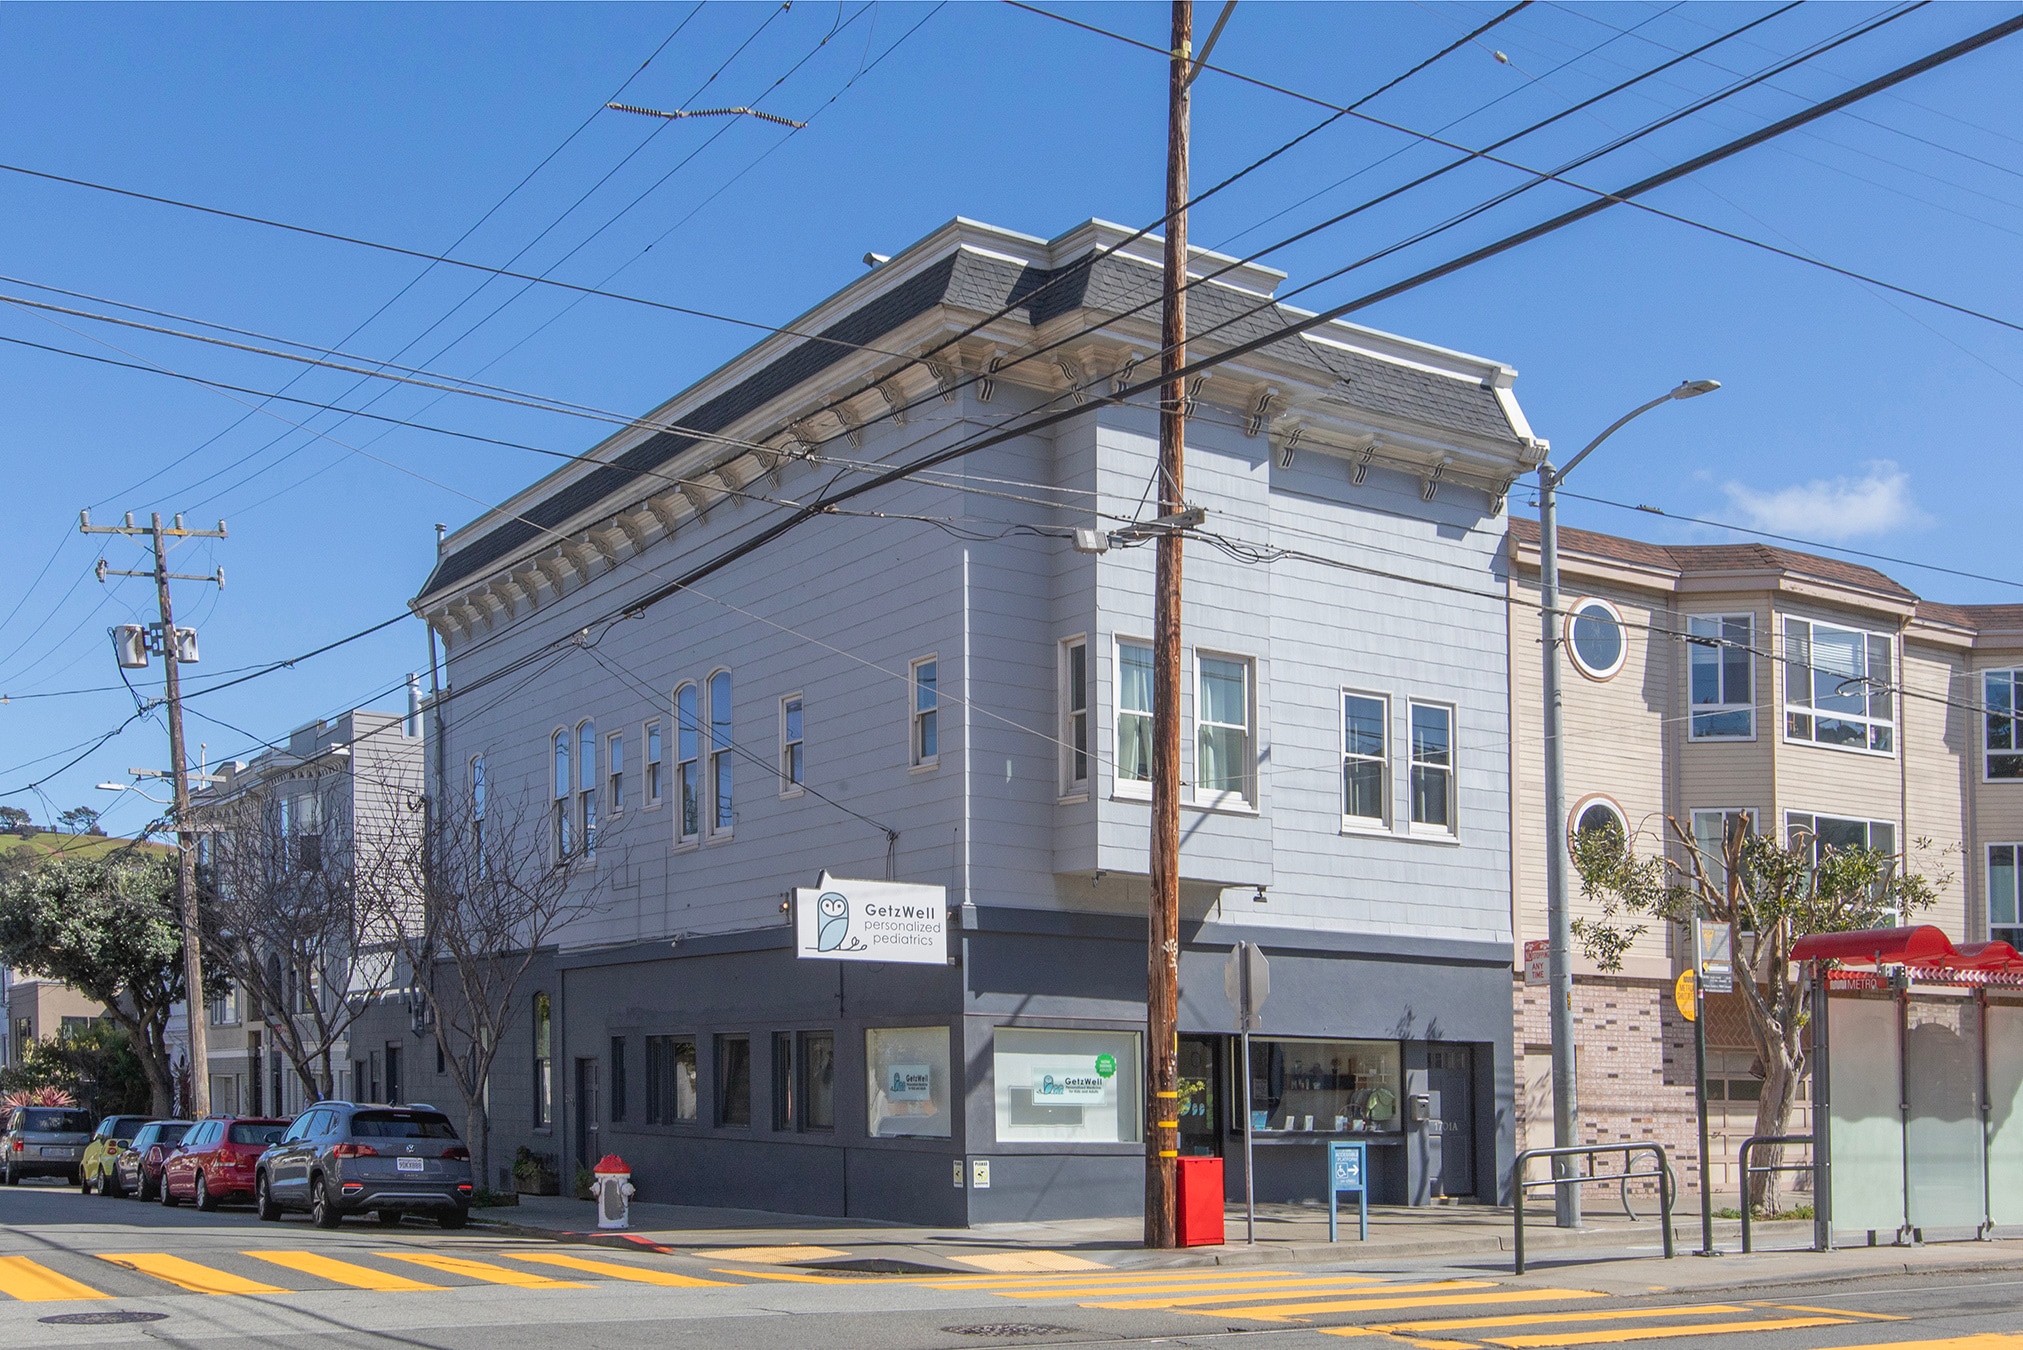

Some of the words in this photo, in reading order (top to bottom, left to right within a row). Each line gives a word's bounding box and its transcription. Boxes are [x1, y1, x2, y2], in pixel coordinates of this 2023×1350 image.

[865, 903, 935, 919] GetzWell
[864, 920, 941, 933] personalized
[873, 933, 933, 946] pediatrics
[1532, 962, 1544, 970] ANY
[1532, 970, 1544, 979] TIME
[1847, 979, 1878, 990] METRO
[1065, 1077, 1103, 1086] GetzWell
